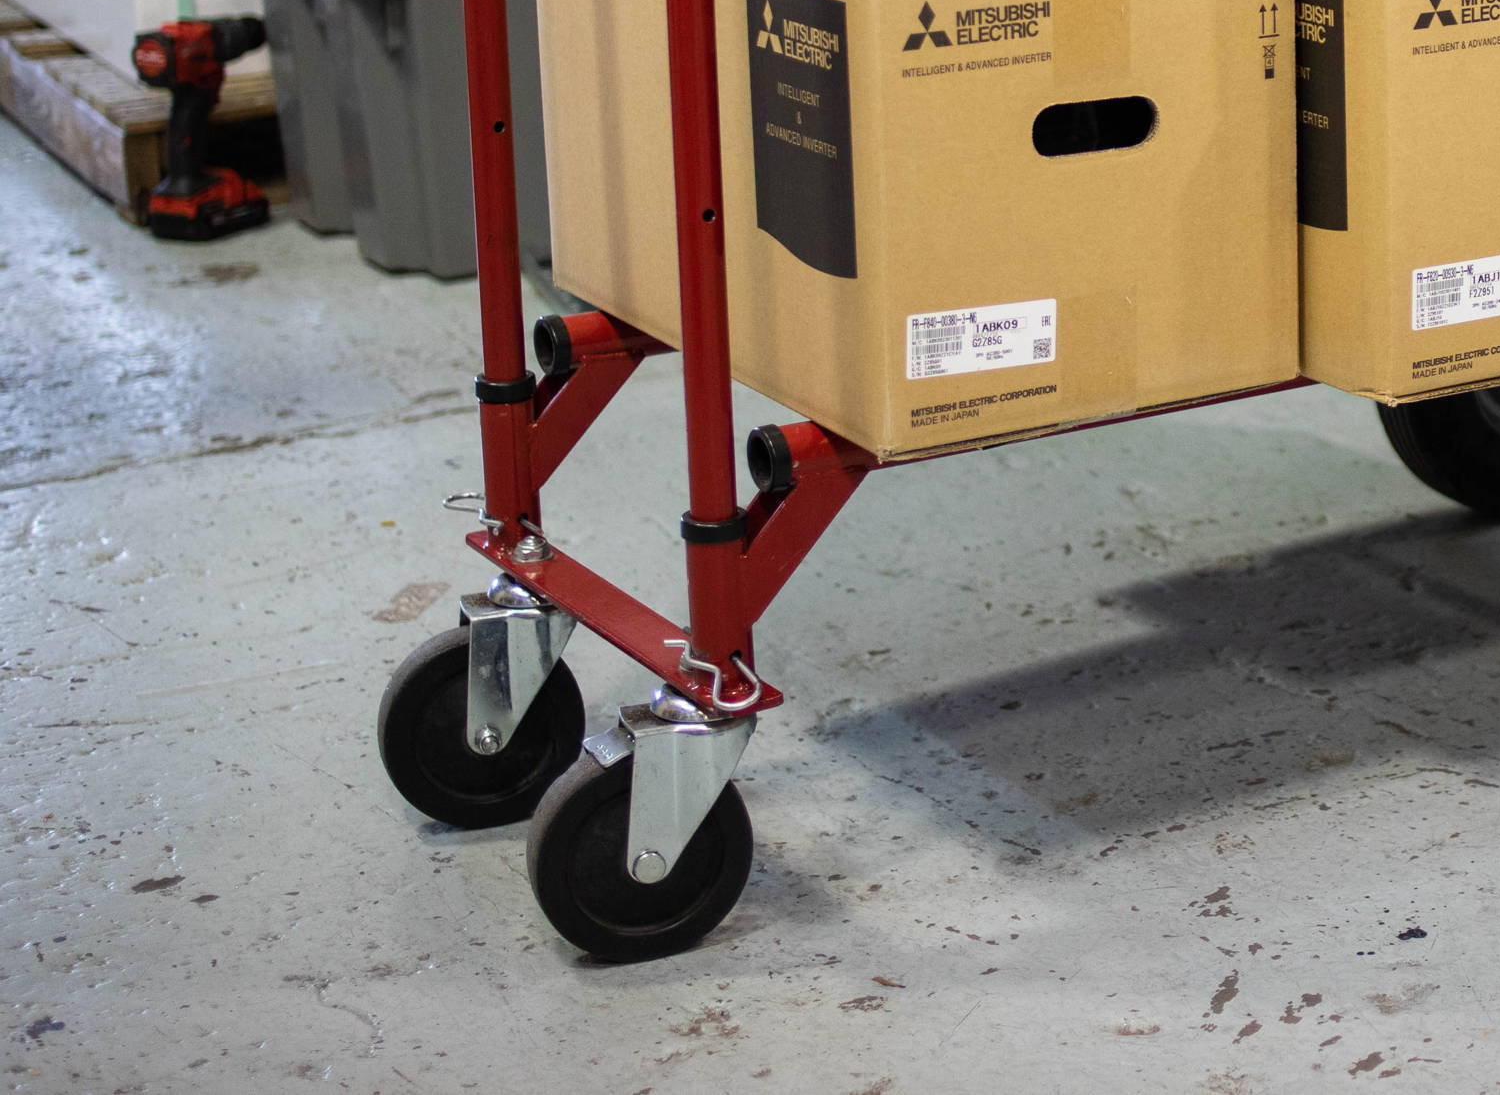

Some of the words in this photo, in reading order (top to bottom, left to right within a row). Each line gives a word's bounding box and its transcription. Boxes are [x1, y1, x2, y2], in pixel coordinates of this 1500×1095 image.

[956, 1, 1050, 27] MITSUBISHI
[783, 19, 839, 53] MITSUBISHI
[957, 20, 1039, 45] ELECTRIC
[784, 38, 832, 70] ELECTRIC
[1413, 41, 1459, 55] INTELLIGENT
[1461, 41, 1466, 49] &
[902, 64, 955, 78] INTELLIGENT
[957, 62, 963, 72] &
[966, 58, 1009, 71] ADVANCED
[1012, 51, 1052, 65] INVERTER
[777, 81, 820, 107] INTELLIGENT
[1303, 110, 1329, 129] ERTER
[766, 121, 801, 146] ADVANCED
[803, 135, 837, 159] INVERTER
[976, 319, 1018, 333] 1ABK09
[1412, 366, 1437, 380] MADE
[1438, 365, 1446, 375] IN
[1448, 361, 1473, 374] JAPAN
[1413, 355, 1453, 370] MITSUBISHI
[1455, 347, 1489, 362] ELECTRIC
[911, 403, 957, 418] MITSUBISHI
[959, 395, 998, 410] ELECTRIC
[1000, 384, 1057, 402] CORPORATION
[911, 414, 939, 428] MADE
[941, 413, 949, 423] IN
[951, 409, 980, 422] JAPAN
